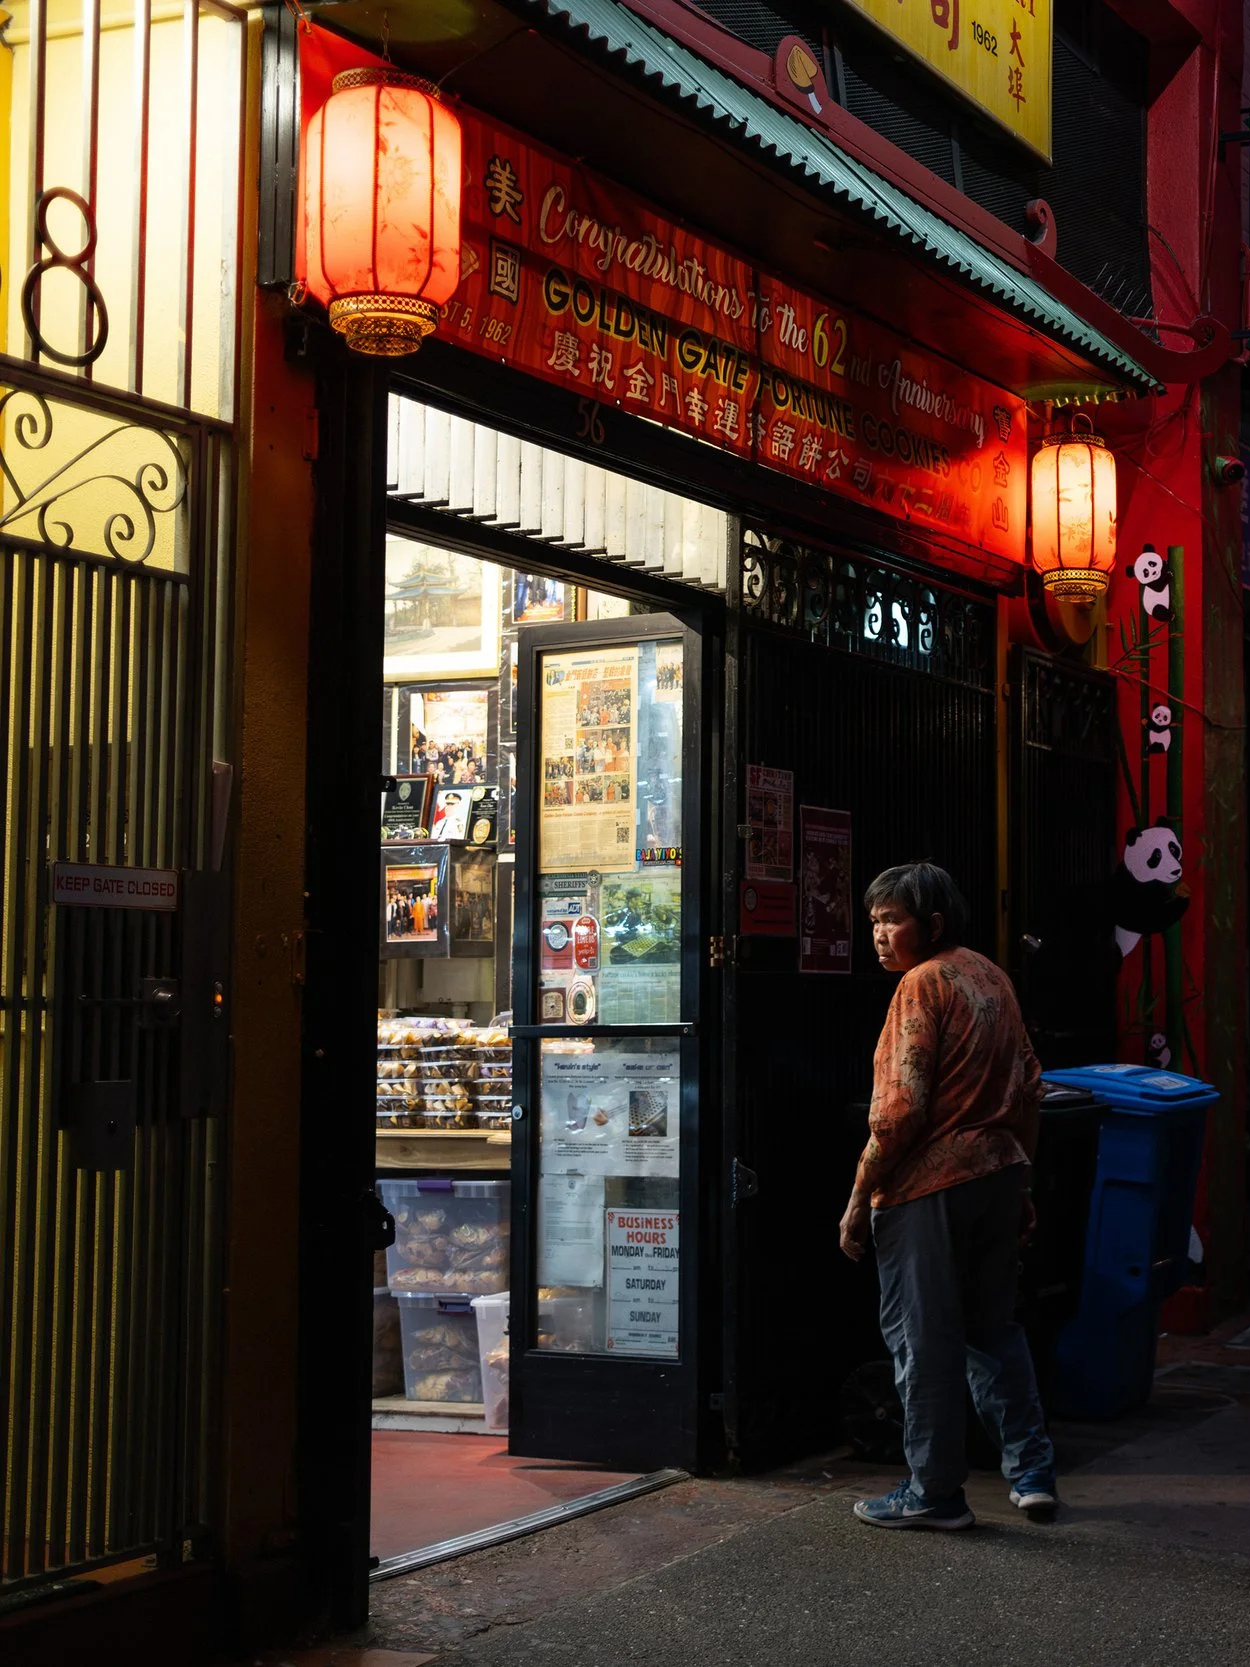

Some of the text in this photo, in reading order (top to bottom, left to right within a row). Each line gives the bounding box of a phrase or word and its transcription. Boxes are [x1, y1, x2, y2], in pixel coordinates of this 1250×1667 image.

[971, 20, 998, 57] 1962
[539, 185, 744, 320] Congratulations
[776, 302, 809, 354] the
[461, 307, 472, 333] 5,
[480, 316, 511, 345] 1962
[542, 267, 669, 362] GOLDEN
[676, 327, 750, 395] GATE
[753, 360, 857, 441] FORTUNE
[859, 408, 951, 481] COOKIES
[576, 398, 606, 445] 56
[57, 876, 175, 897] KEEP GATE CLOSED
[618, 1216, 674, 1230] BUSINESS
[627, 1231, 667, 1244] HOURS
[611, 1245, 644, 1257] MONDAY
[653, 1246, 680, 1258] FRIDAY
[625, 1278, 666, 1291] SATURDAY
[629, 1310, 662, 1323] SUNDAY
